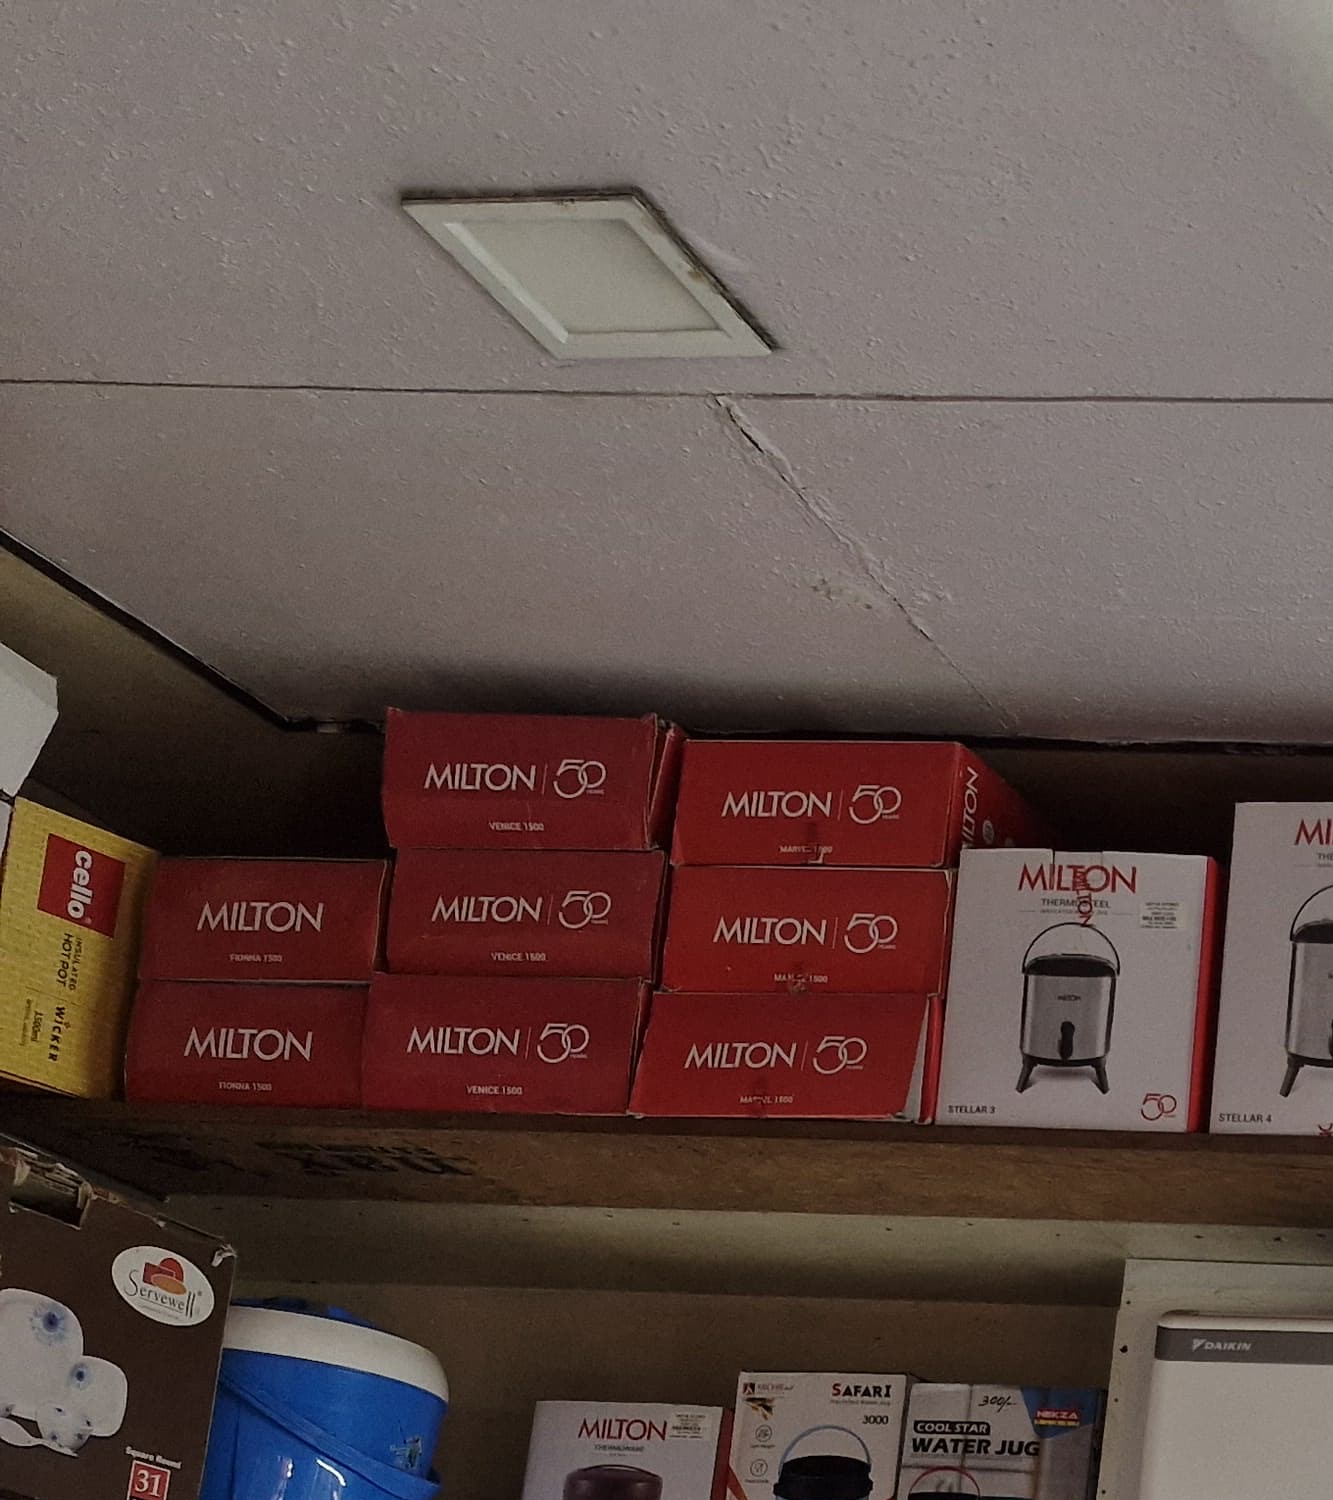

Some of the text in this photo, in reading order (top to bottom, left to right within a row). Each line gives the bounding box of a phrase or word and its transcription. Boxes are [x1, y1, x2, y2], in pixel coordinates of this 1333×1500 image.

[424, 763, 536, 791] MILTON
[721, 791, 832, 818] MILTON
[67, 850, 93, 919] cello
[1018, 864, 1136, 893] MILTON
[196, 902, 324, 932] MILTON
[432, 896, 542, 922] MILTON
[713, 917, 826, 945] MILTON
[57, 932, 73, 987] HOT POT
[47, 1006, 66, 1062] WICKER
[184, 1028, 313, 1062] MILTON
[407, 1026, 520, 1055] MILTON
[683, 1041, 797, 1069] MILTON
[466, 1085, 499, 1095] VENICE
[948, 1104, 986, 1114] STELLAR
[1218, 1113, 1263, 1123] STELLAR
[1265, 1114, 1272, 1123] 4
[122, 1268, 197, 1319] Servewell
[1204, 1341, 1251, 1351] DAIKIN
[832, 1383, 892, 1399] SAFARI
[578, 1418, 667, 1442] MILTON
[862, 1415, 889, 1426] 3000
[916, 1423, 987, 1434] COOL STAR
[912, 1438, 1040, 1457] WATER JUG
[134, 1470, 165, 1499] 31
